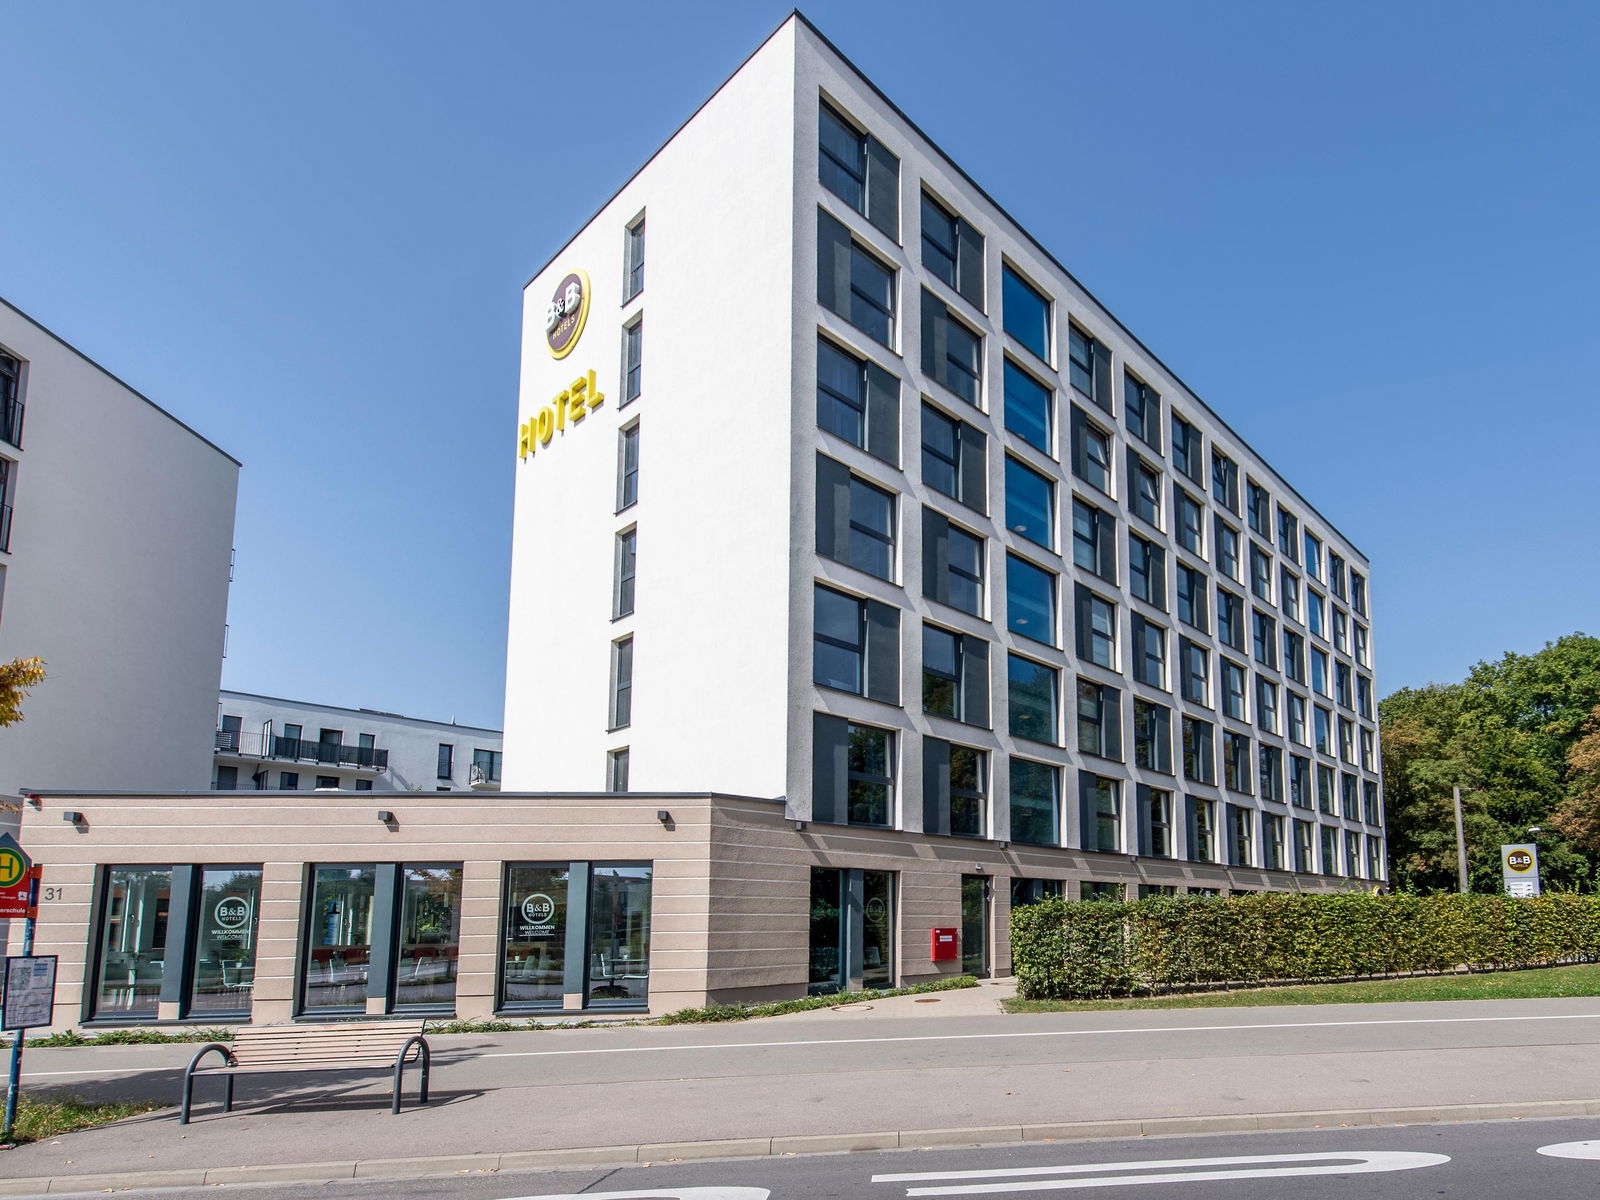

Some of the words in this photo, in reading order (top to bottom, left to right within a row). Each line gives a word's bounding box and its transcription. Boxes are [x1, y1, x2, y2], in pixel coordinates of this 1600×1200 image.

[546, 282, 581, 332] B&B
[552, 315, 575, 341] HOTELS
[519, 369, 605, 459] HOTEL
[1509, 856, 1531, 865] B&B
[44, 887, 63, 901] 31
[220, 906, 245, 917] B&B
[527, 903, 550, 913] B&B
